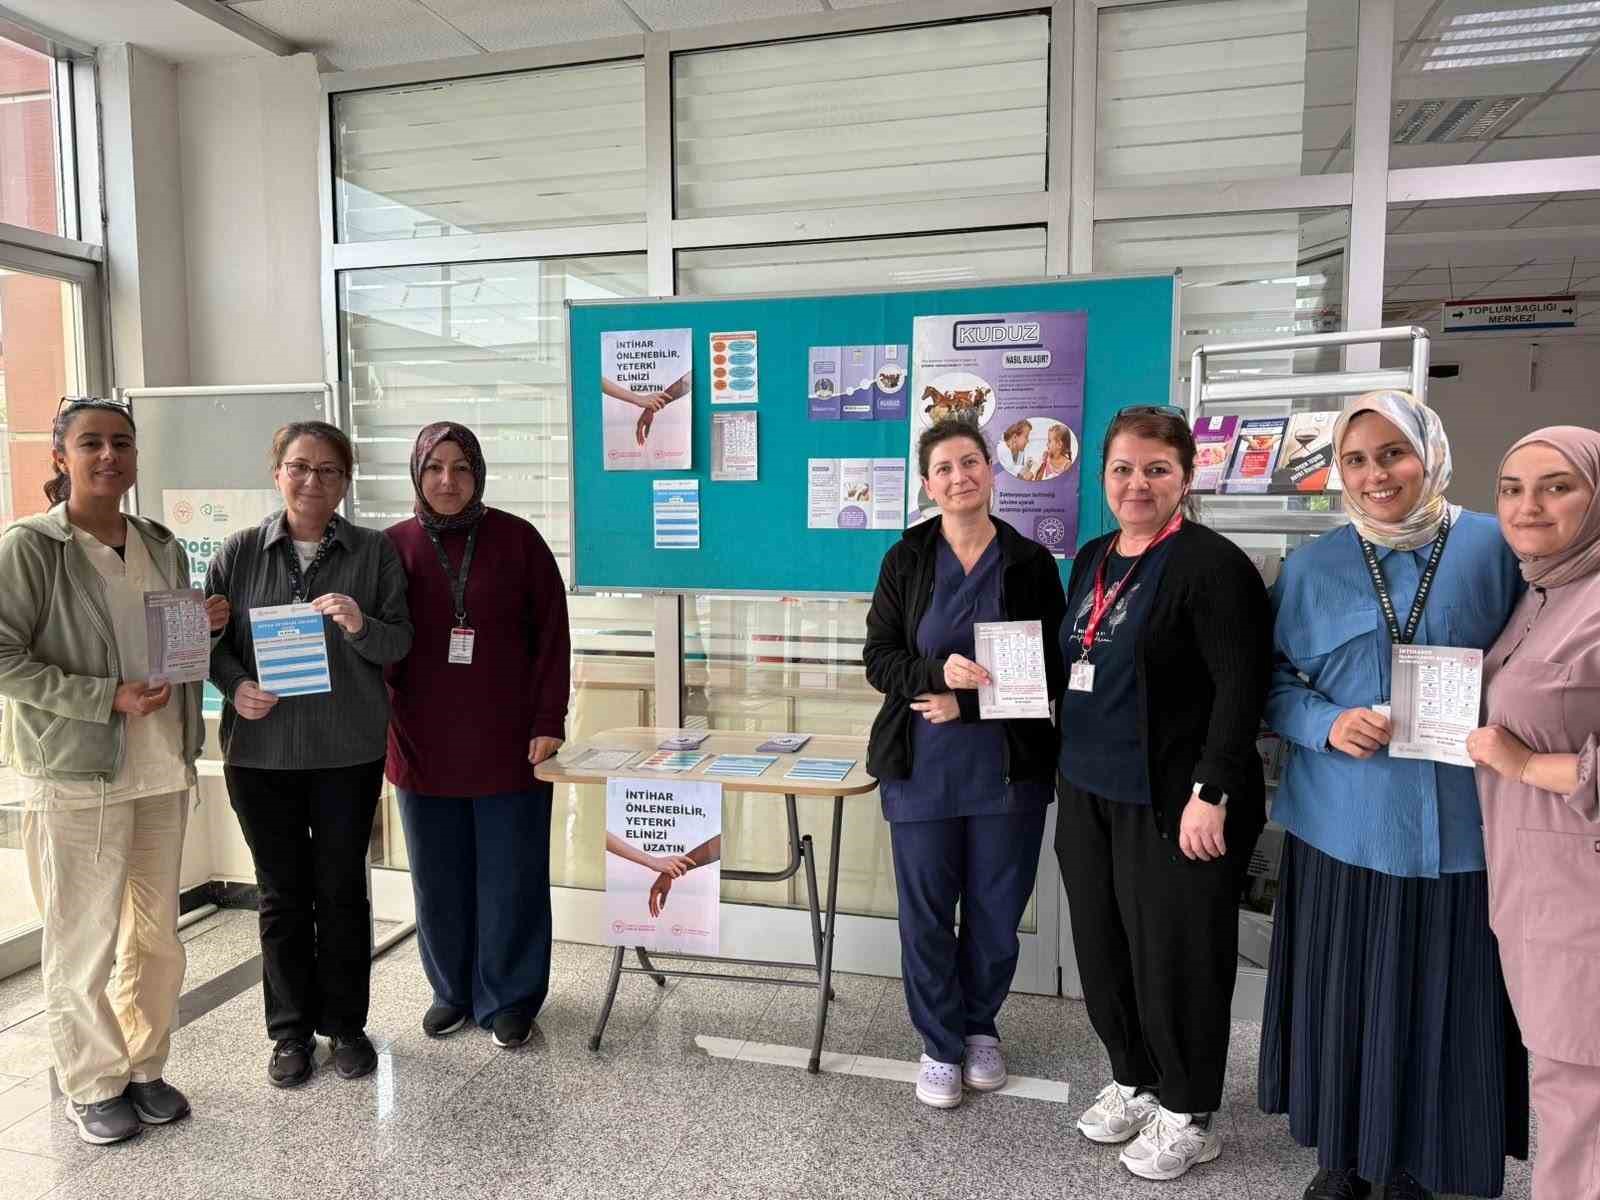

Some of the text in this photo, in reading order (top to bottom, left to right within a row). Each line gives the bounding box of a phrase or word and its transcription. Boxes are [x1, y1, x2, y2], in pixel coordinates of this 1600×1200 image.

[1468, 303, 1512, 315] TOPLUM
[1488, 314, 1536, 324] MERKEZİ
[960, 324, 1038, 344] KUDUZ
[616, 339, 654, 349] İNTİHAR
[616, 349, 681, 360] ÖNLENEBİLİR,
[1006, 353, 1049, 366] NASIL BULAŞIR?
[616, 361, 656, 371] YETERKİ
[617, 373, 650, 382] ELİNİZİ
[631, 384, 663, 392] UZATIN
[625, 788, 674, 801] İNTİHAR
[625, 803, 707, 818] ÖNLENEBİLİR,
[625, 816, 676, 828] YETERKİ
[625, 829, 668, 840] ELİNİZİ
[643, 843, 685, 853] UZATIN
